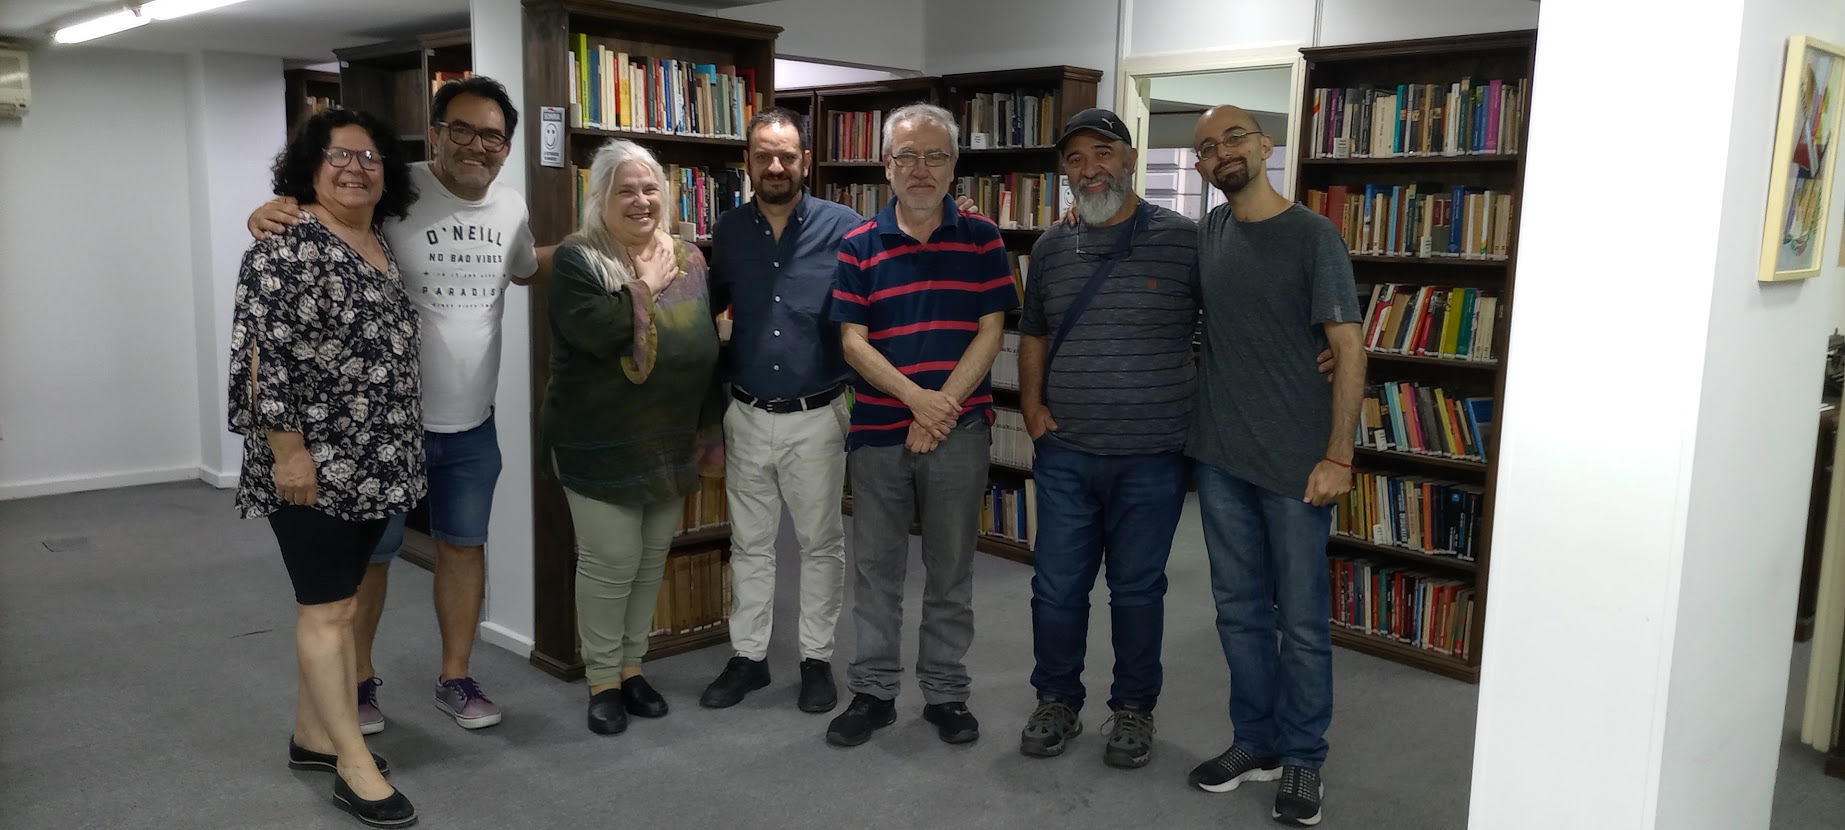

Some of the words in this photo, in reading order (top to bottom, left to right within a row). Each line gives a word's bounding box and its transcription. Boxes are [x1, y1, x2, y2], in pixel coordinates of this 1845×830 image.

[426, 225, 502, 247] O'NEILL
[429, 253, 444, 262] NO
[451, 254, 471, 263] BAD
[476, 254, 502, 263] VIBES
